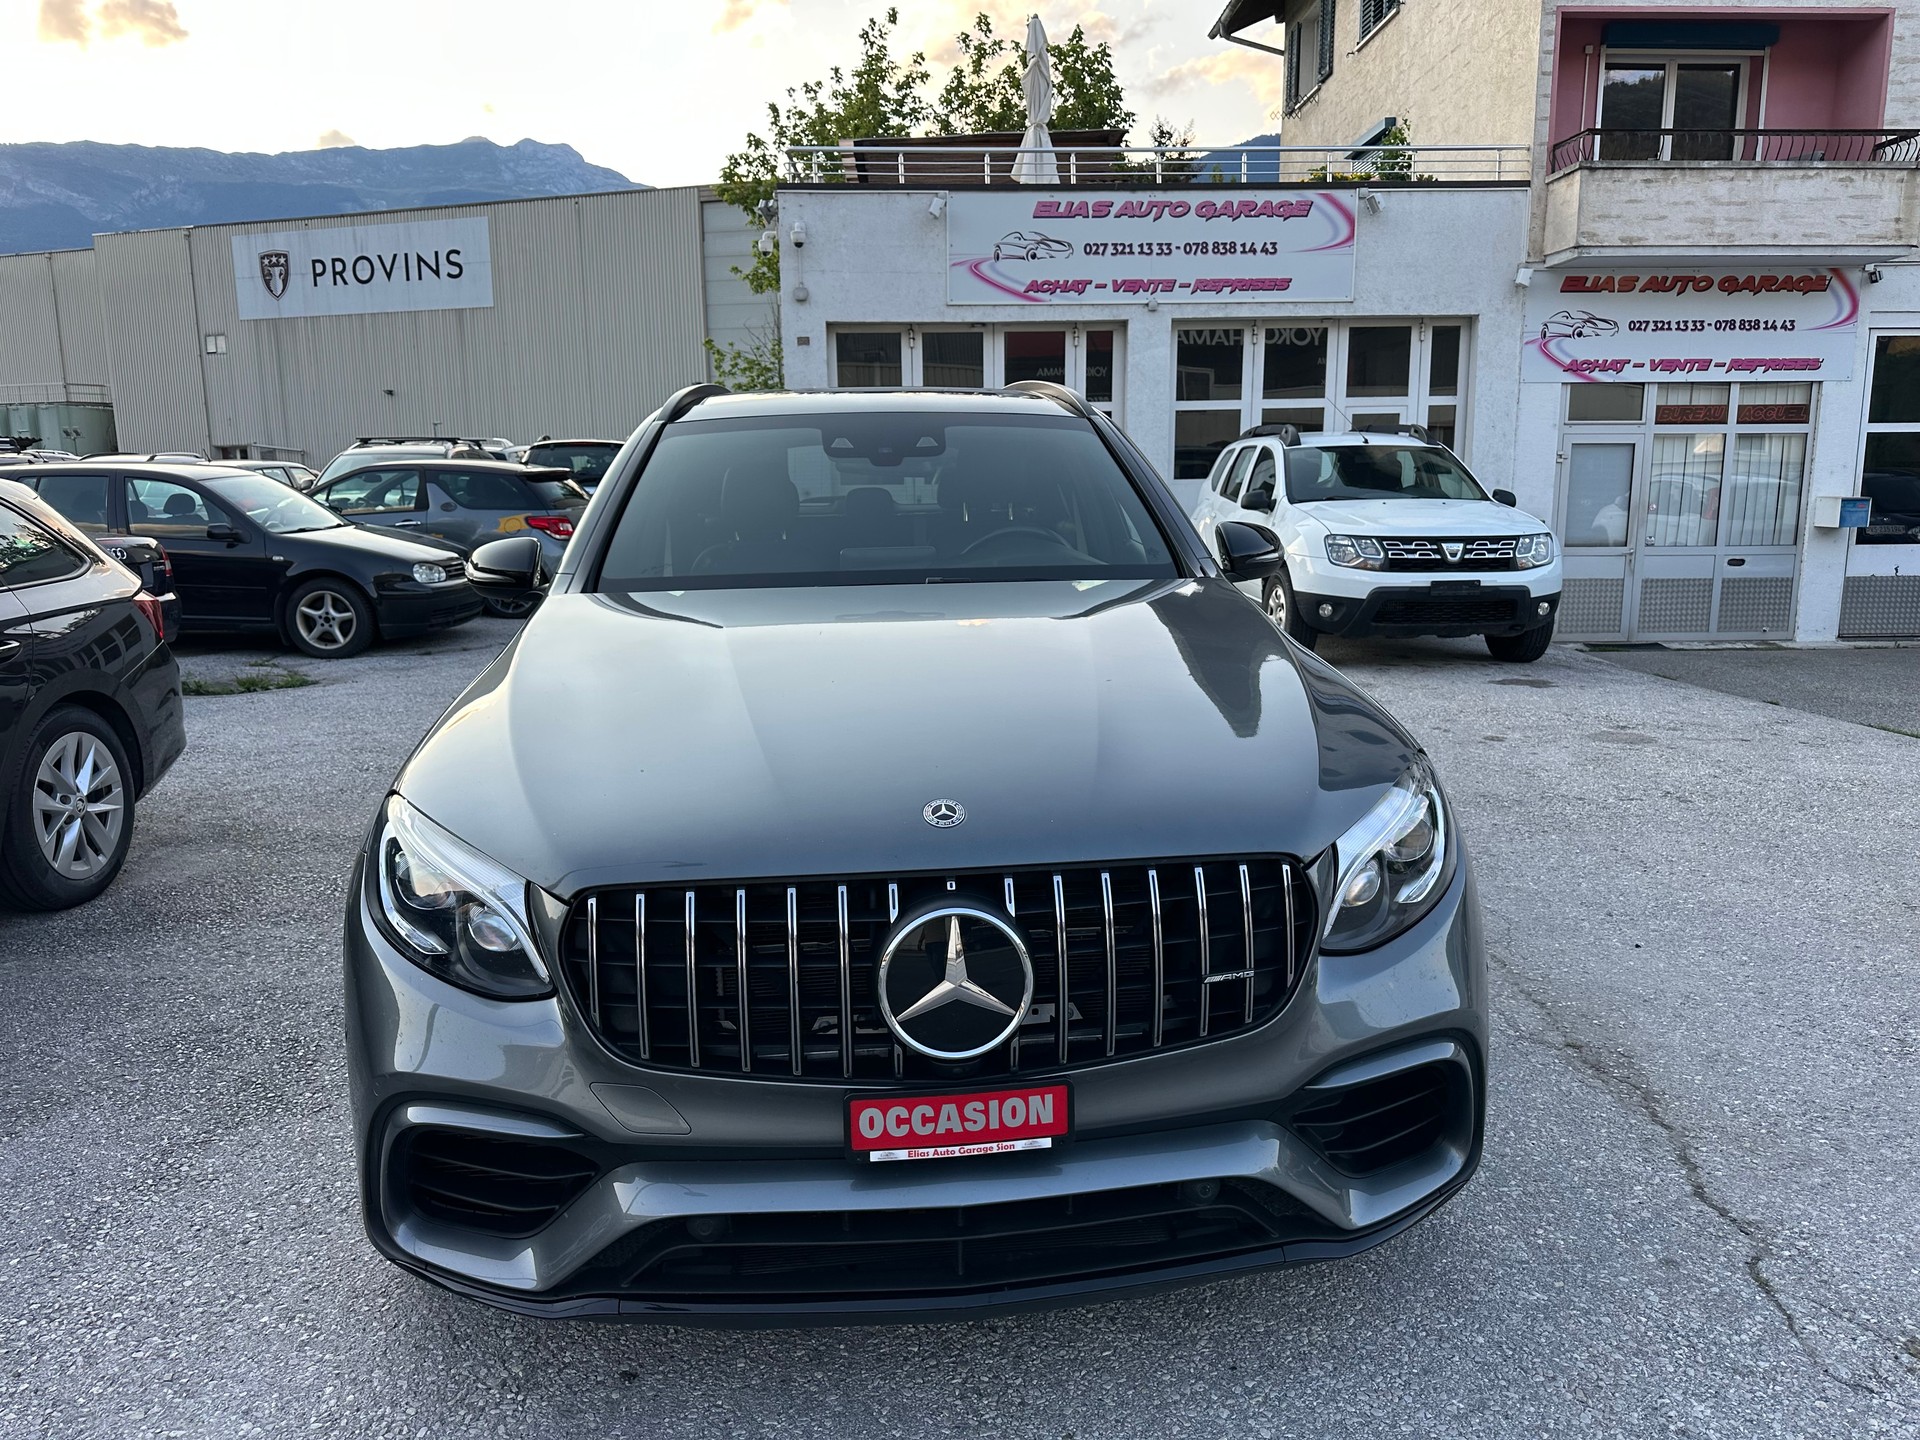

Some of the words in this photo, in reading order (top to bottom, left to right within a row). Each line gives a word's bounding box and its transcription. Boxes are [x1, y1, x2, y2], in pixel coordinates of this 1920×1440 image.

[1033, 200, 1114, 219] ELIAS
[1114, 200, 1192, 222] AUTO
[1195, 200, 1314, 222] GARAGE
[1084, 243, 1108, 256] 027
[1111, 243, 1135, 256] 321
[1137, 243, 1153, 256] 13
[1156, 243, 1173, 256] 33
[1183, 242, 1209, 256] 078
[1212, 241, 1238, 255] 838
[1240, 242, 1257, 255] 14
[1260, 242, 1278, 255] 43
[311, 249, 464, 287] PROVINS
[1023, 279, 1093, 295] ACHAT
[1111, 279, 1177, 295] VENTE
[1191, 278, 1292, 295] REPRISES
[1560, 276, 1639, 293] ELIAS
[1639, 275, 1715, 297] AUTO
[1718, 275, 1833, 296] GARAGE
[1628, 320, 1650, 333] 027
[1651, 320, 1672, 332] 321
[1675, 320, 1689, 332] 13
[1691, 320, 1706, 332] 33
[1714, 319, 1736, 332] 078
[1738, 319, 1761, 331] 838
[1763, 319, 1778, 331] 14
[1780, 319, 1796, 331] 43
[1563, 359, 1631, 375] ACHAT
[1649, 358, 1713, 374] VENTE
[1726, 358, 1824, 374] REPRISES
[1658, 406, 1726, 422] BUREAU
[1220, 970, 1254, 981] AMG
[858, 1093, 1054, 1139] OCCASION
[907, 1150, 930, 1158] Elias
[932, 1148, 956, 1157] Auto
[958, 1146, 994, 1155] Garage
[996, 1143, 1016, 1152] Sion
